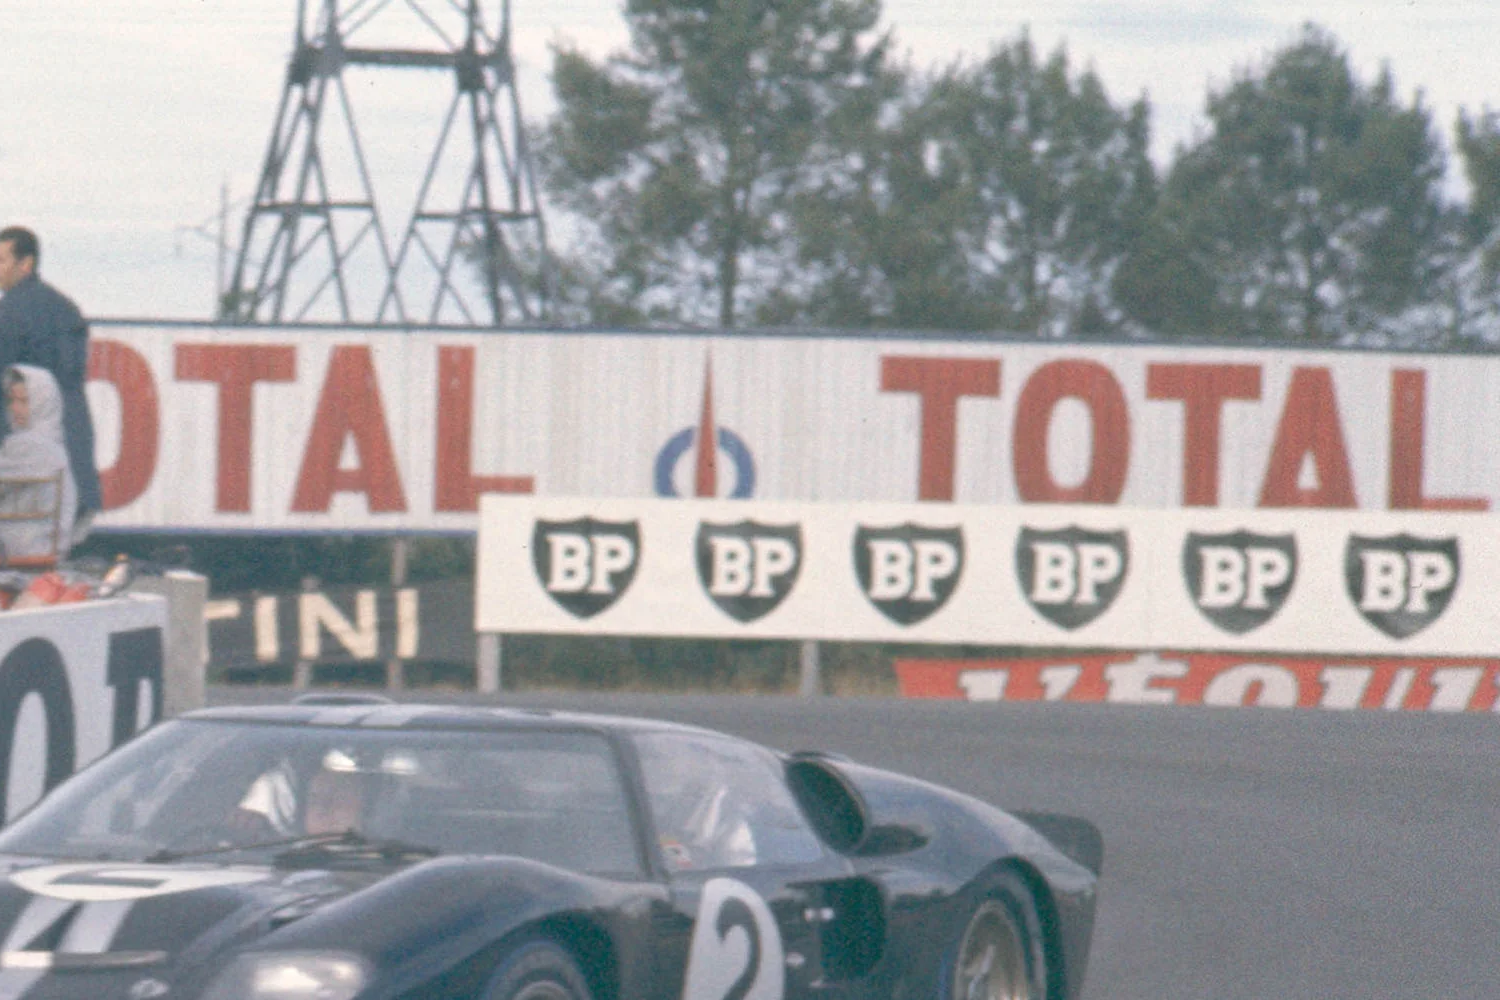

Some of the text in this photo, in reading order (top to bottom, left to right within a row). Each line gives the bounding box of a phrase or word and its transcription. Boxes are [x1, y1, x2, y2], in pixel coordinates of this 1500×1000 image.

[880, 355, 1490, 510] TOTAL
[545, 533, 1454, 613] BP BP BP BP BP BP
[202, 588, 419, 660] INI
